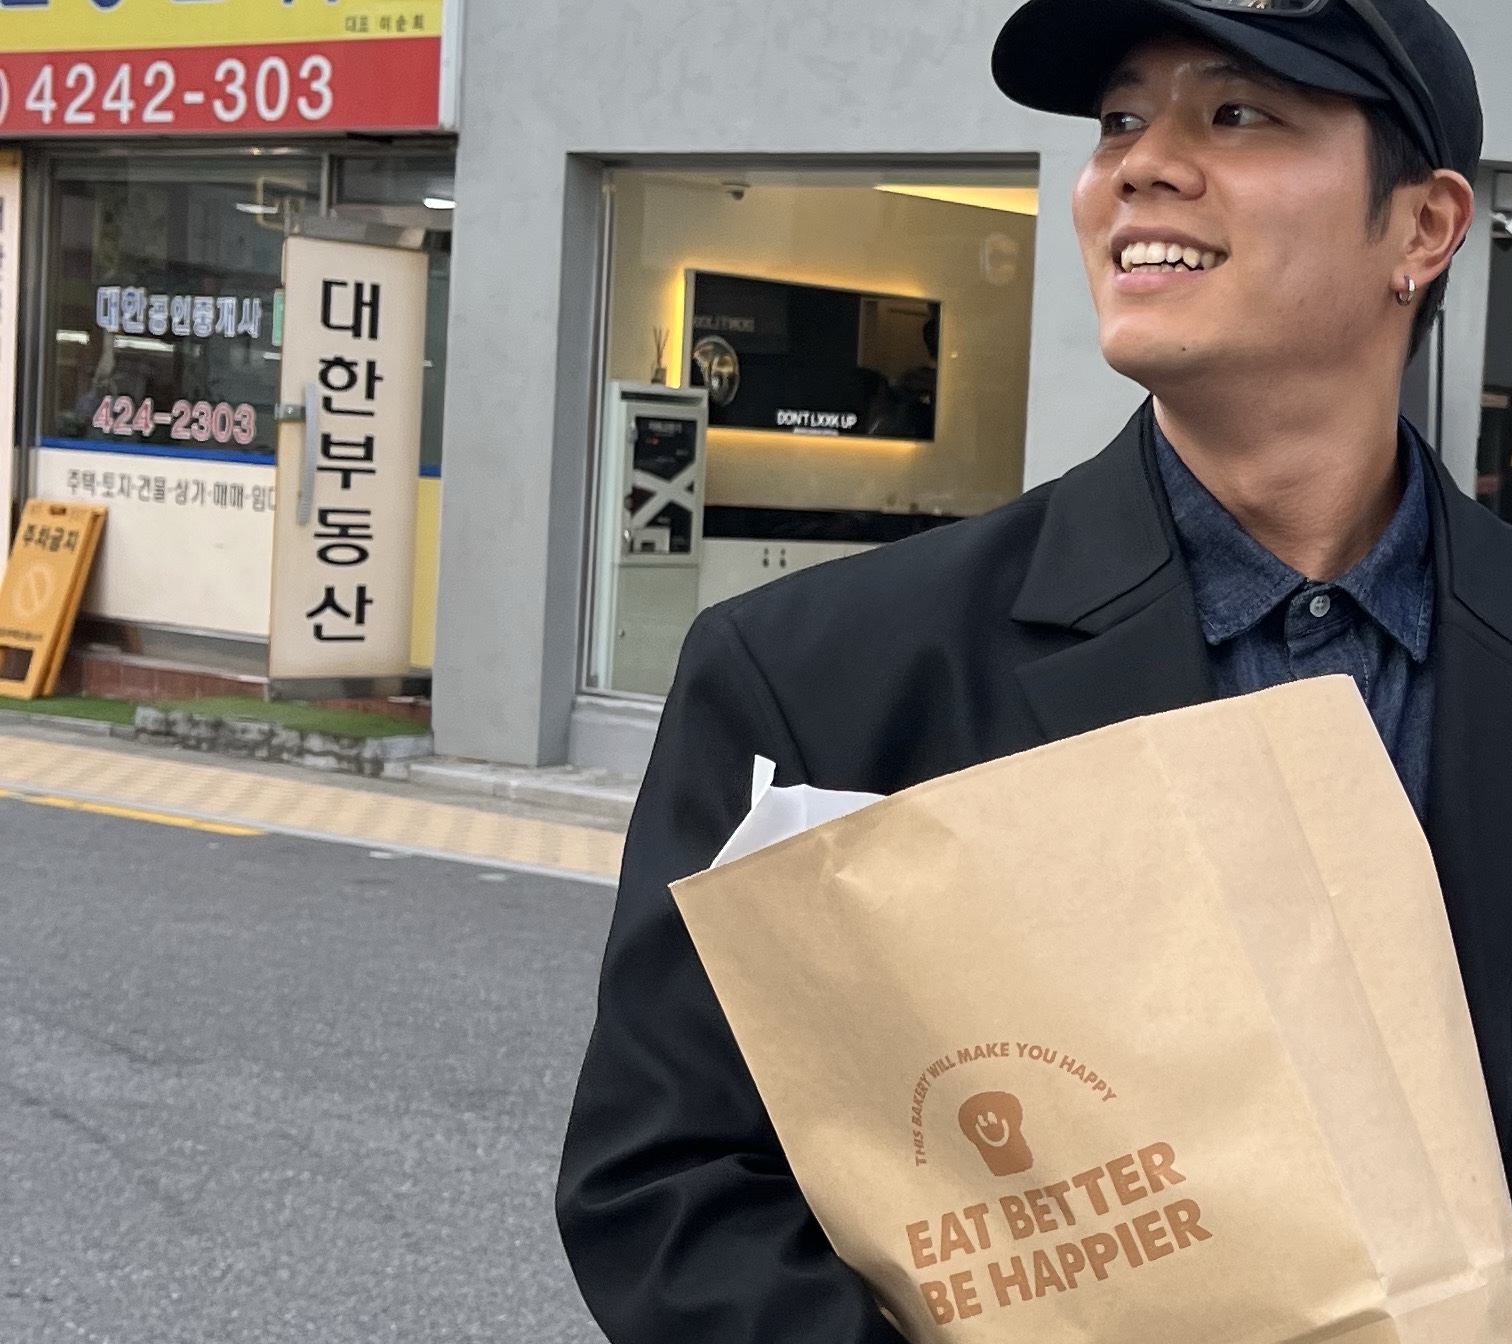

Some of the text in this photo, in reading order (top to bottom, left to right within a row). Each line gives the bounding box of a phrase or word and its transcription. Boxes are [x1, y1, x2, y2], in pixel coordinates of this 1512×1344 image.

[96, 285, 262, 338] 대한공인중개사
[92, 395, 257, 445] 424-2303
[306, 278, 383, 644] 대한부동산
[912, 1042, 1118, 1166] THIS BAKERY WILL MAKE YOU HAPPY
[905, 1141, 1187, 1269] EAT BETTER
[919, 1198, 1213, 1325] BE HAPPIER
